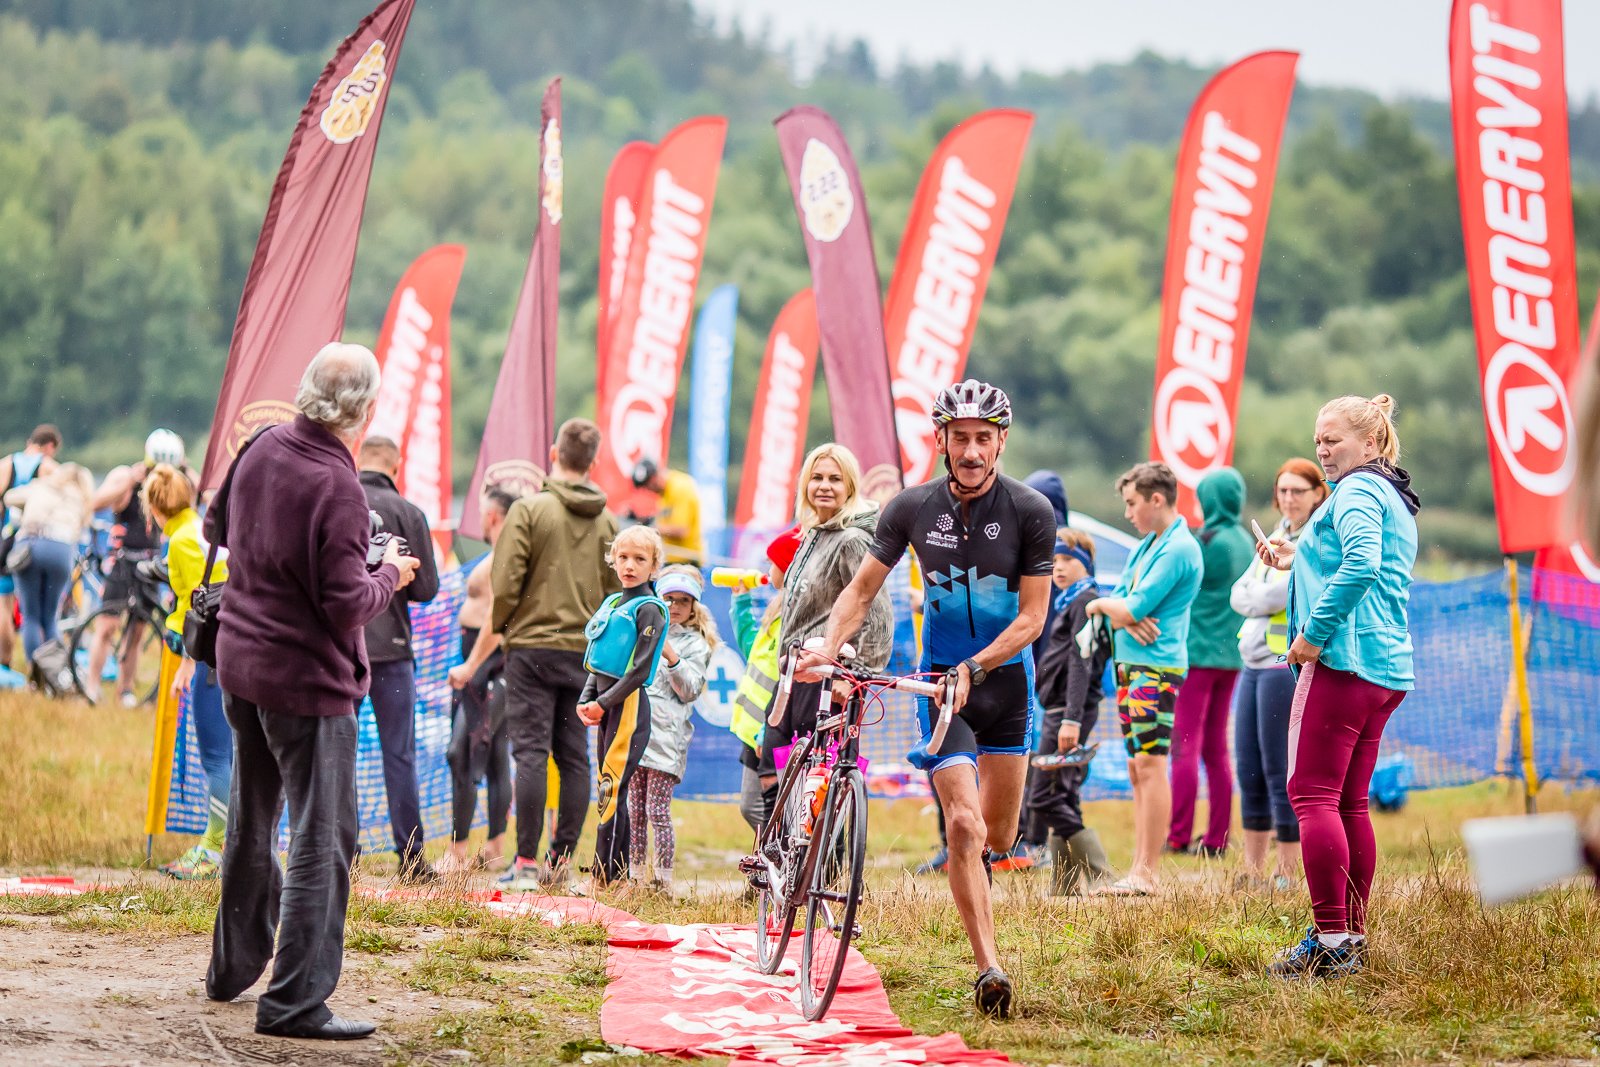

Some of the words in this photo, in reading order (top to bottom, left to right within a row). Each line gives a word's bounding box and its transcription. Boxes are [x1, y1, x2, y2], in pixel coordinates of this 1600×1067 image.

[626, 169, 704, 399] ENERVIT
[896, 156, 997, 388] ENERVIT
[1171, 111, 1262, 383] ENERVIT
[1469, 3, 1556, 350] ENERVIT
[925, 539, 958, 549] PROJECT
